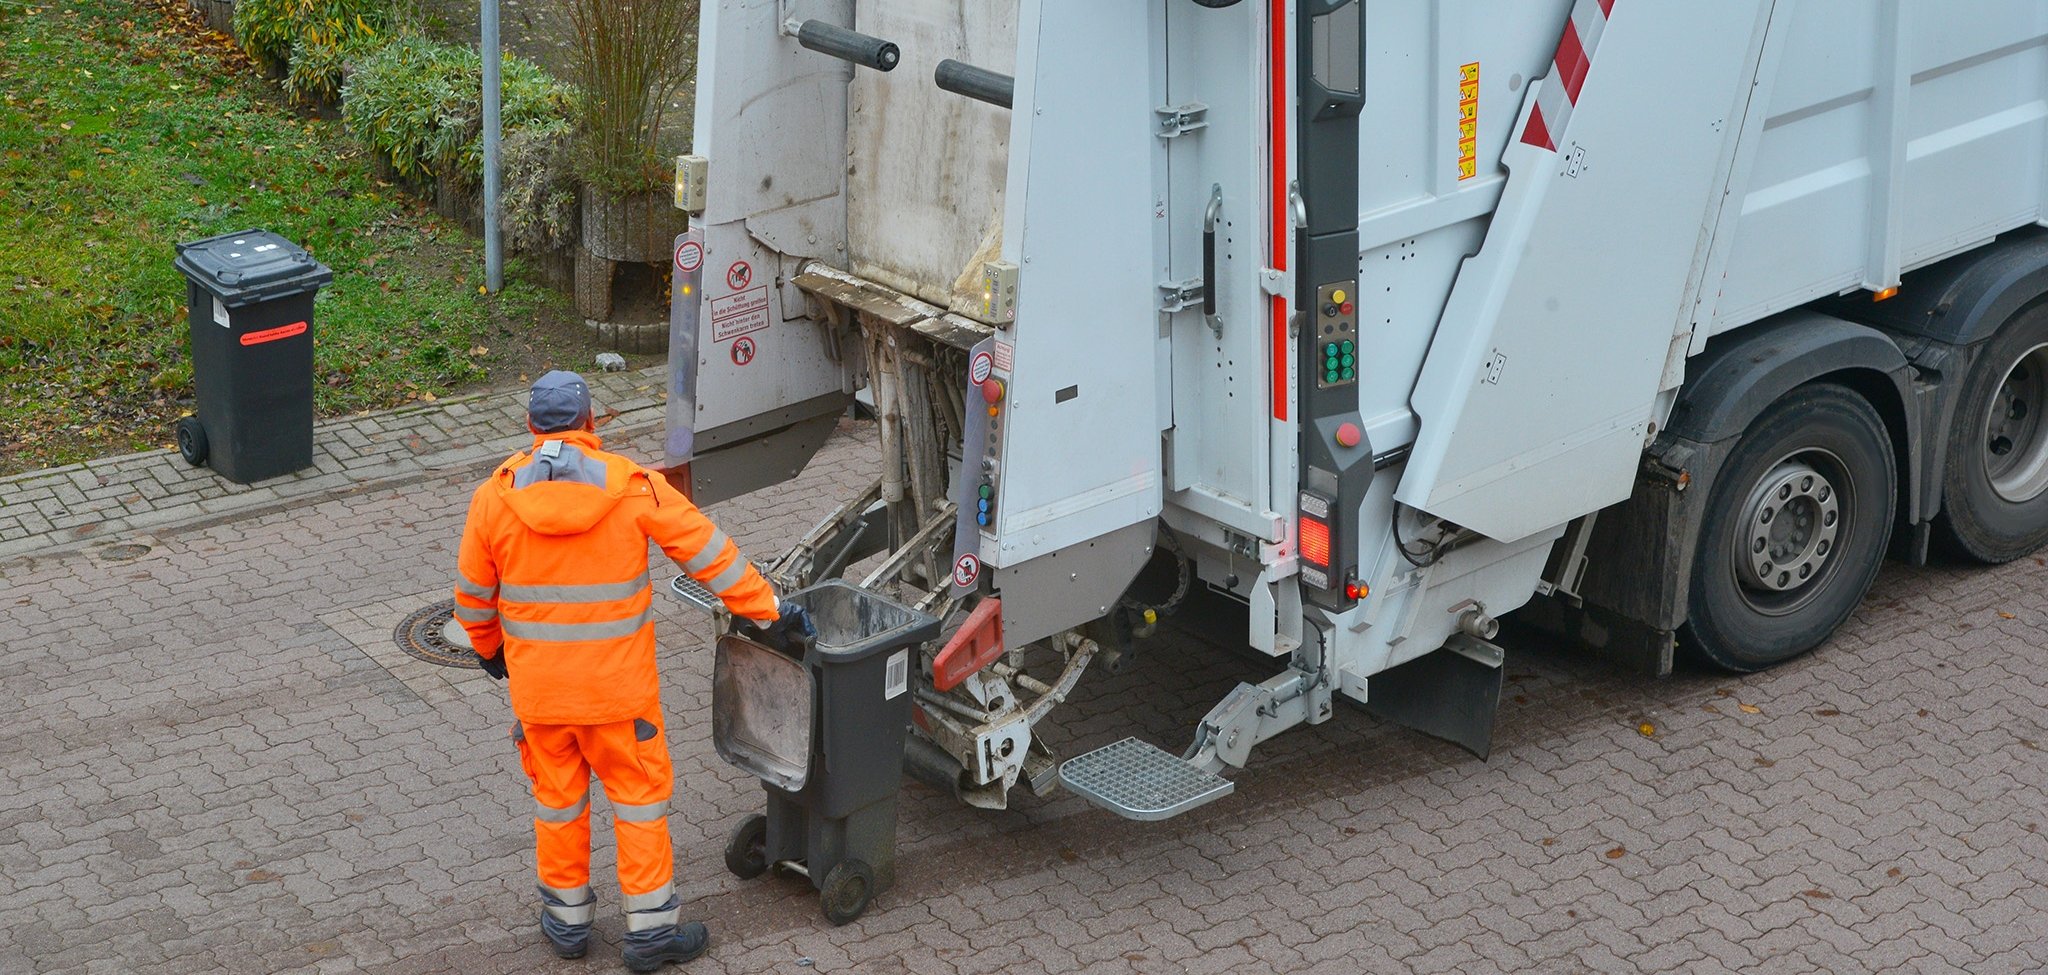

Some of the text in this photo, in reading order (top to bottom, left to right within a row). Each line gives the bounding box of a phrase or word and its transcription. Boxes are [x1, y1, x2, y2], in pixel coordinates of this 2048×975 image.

[718, 320, 764, 337] Schwenkarm treten
[722, 320, 735, 328] Nicht
[735, 316, 750, 324] hinter
